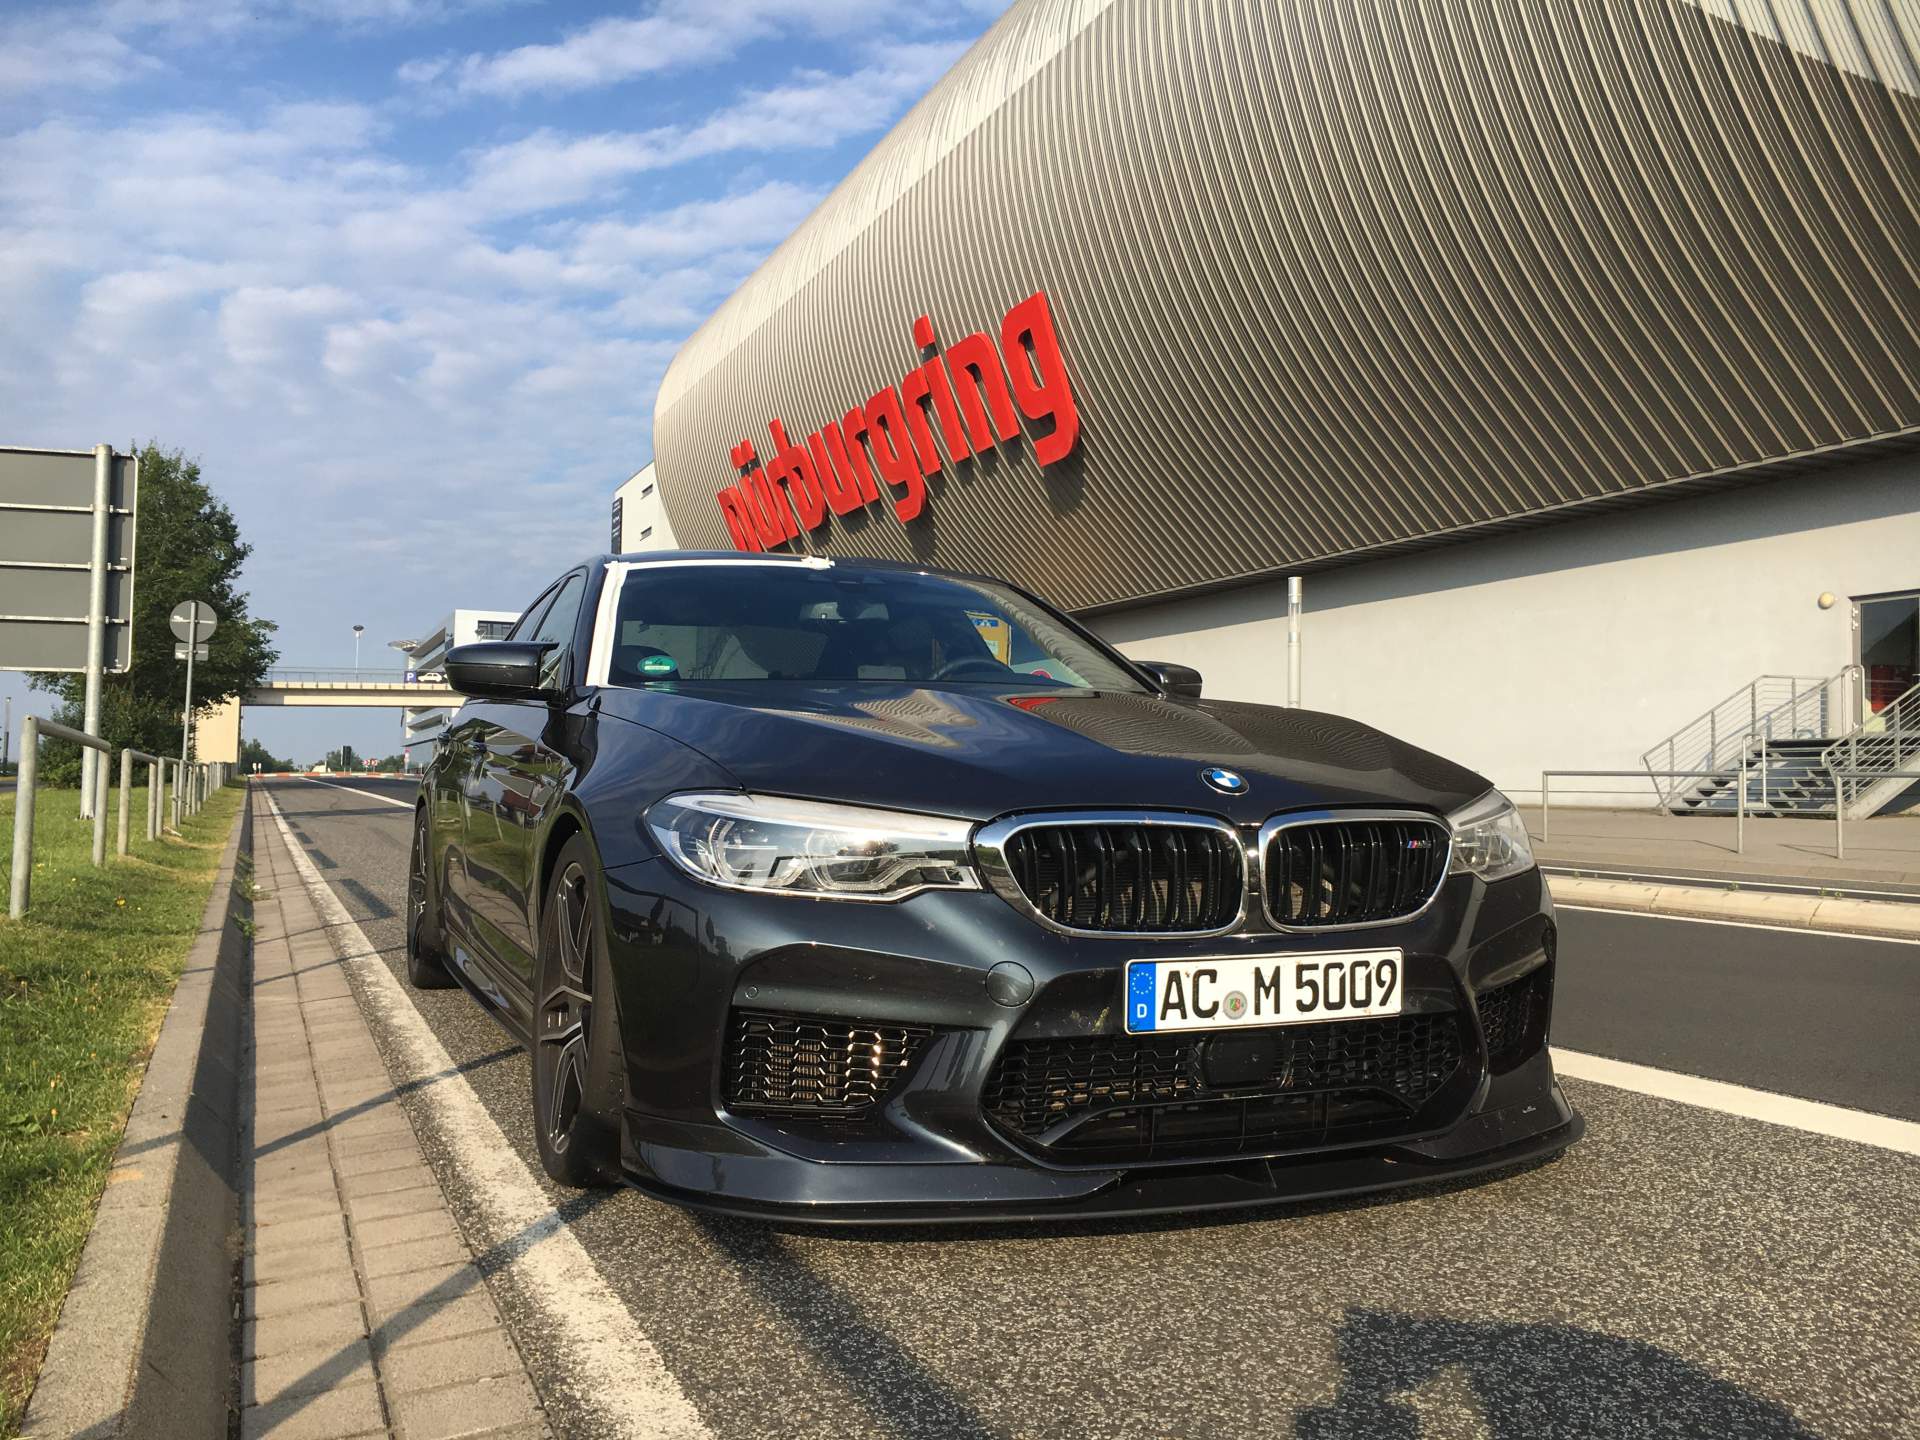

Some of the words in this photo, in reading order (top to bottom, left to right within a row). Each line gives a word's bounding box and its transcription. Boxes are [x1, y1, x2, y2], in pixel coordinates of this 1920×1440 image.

[717, 290, 1080, 552] nürburgring
[407, 672, 414, 681] P
[1160, 968, 1220, 1021] AC
[1253, 965, 1281, 1016] M
[1295, 959, 1398, 1013] 5009
[1136, 1003, 1148, 1018] D
